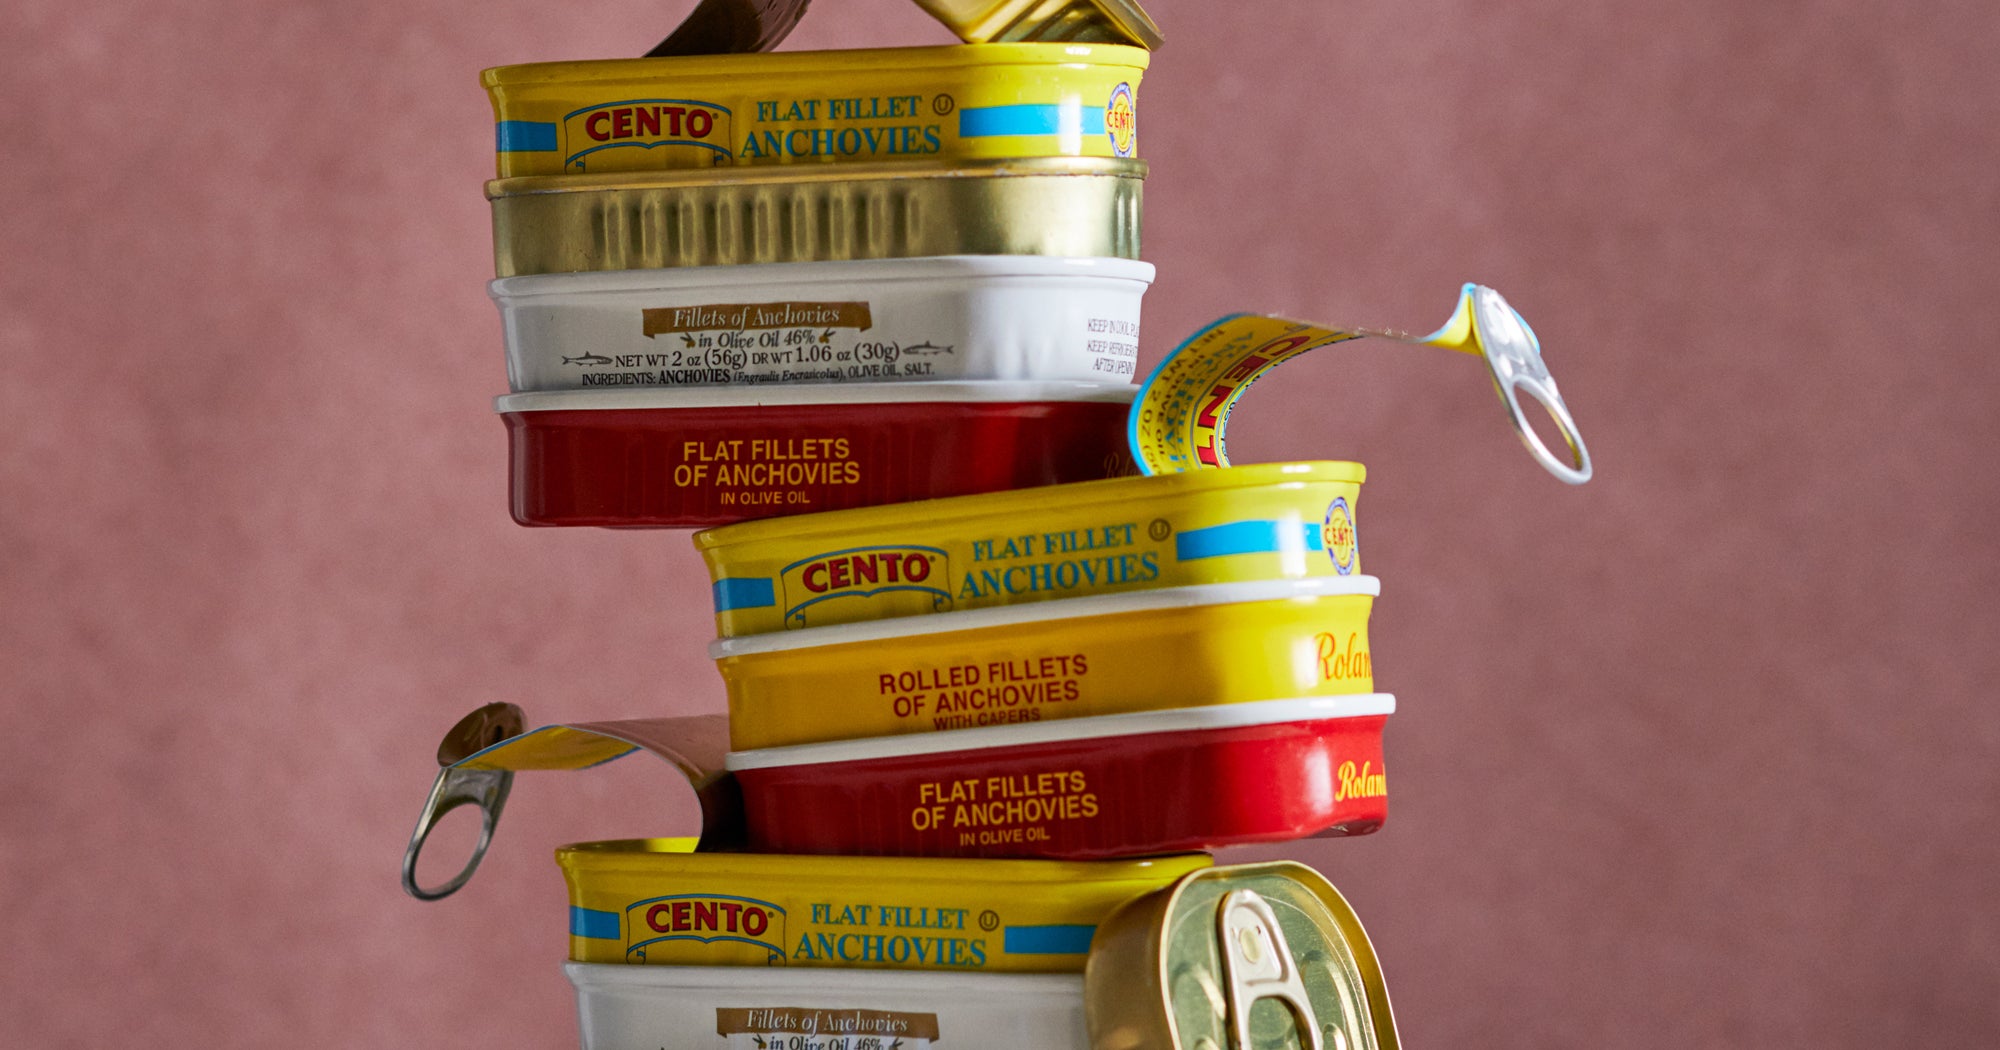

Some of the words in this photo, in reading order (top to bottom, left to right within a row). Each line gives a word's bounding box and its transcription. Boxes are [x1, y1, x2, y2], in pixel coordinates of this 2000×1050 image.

[585, 106, 714, 141] CENTO
[757, 100, 820, 122] FLAT
[828, 96, 922, 120] FILLET
[739, 124, 941, 158] ANCHOVIES
[673, 307, 727, 328] Fillets
[731, 306, 750, 335] of
[752, 303, 840, 326] Anchovies
[1088, 318, 1108, 332] KEEP
[698, 332, 713, 347] in
[717, 331, 755, 349] Olive
[759, 329, 779, 347] Oil
[783, 329, 816, 345] 46%
[1087, 340, 1108, 353] KEEP
[615, 355, 643, 368] NET
[646, 354, 669, 367] WT
[671, 350, 683, 367] 2
[687, 356, 701, 366] oz
[704, 347, 748, 370] (56g)
[752, 352, 769, 365] DR
[770, 351, 793, 364] WT
[796, 345, 832, 363] 1.06
[836, 352, 851, 361] oz
[854, 341, 900, 364] (30g)
[1093, 357, 1115, 374] AFTER
[582, 372, 657, 386] INGREDIENTS:
[658, 369, 731, 385] ANCHOVIES
[849, 364, 880, 378] OLIVE
[904, 363, 935, 377] SALT.
[1197, 335, 1310, 468] CENT
[683, 440, 744, 462] FLAT
[751, 438, 850, 460] FILLETS
[674, 464, 709, 487] OF
[715, 461, 860, 487] ANCHOVIES
[720, 492, 736, 505] IN
[740, 491, 783, 505] OLIVE
[787, 490, 811, 504] OIL
[972, 535, 1036, 562] FLAT
[1043, 523, 1137, 555] FILLET
[802, 553, 931, 593] CENTO
[959, 551, 1160, 599] ANCHOVIES
[1314, 631, 1371, 681] Rolan
[879, 665, 980, 694] ROLLED
[988, 654, 1088, 683] FILLETS
[893, 695, 925, 717] OF
[935, 679, 1080, 713] ANCHOVIES
[933, 714, 973, 731] WITH
[977, 707, 1041, 726] CAPERS
[920, 780, 979, 804] FLAT
[987, 770, 1086, 799] FILLETS
[1335, 760, 1387, 802] Rolan
[911, 807, 946, 831] OF
[953, 793, 1099, 828] ANCHOVIES
[960, 833, 975, 846] IN
[979, 829, 1023, 845] OLIVE
[1026, 827, 1050, 841] OIL
[646, 902, 768, 936] CENTO
[811, 903, 872, 925] FLAT
[878, 906, 969, 930] FILLET
[793, 932, 987, 967] ANCHOVIES
[747, 1009, 797, 1029] Fillets
[801, 1011, 821, 1038] of
[824, 1010, 908, 1032] Anchovies
[770, 1036, 784, 1050] in
[789, 1036, 825, 1050] Olive
[828, 1038, 850, 1050] Oil
[853, 1038, 884, 1050] 46%
